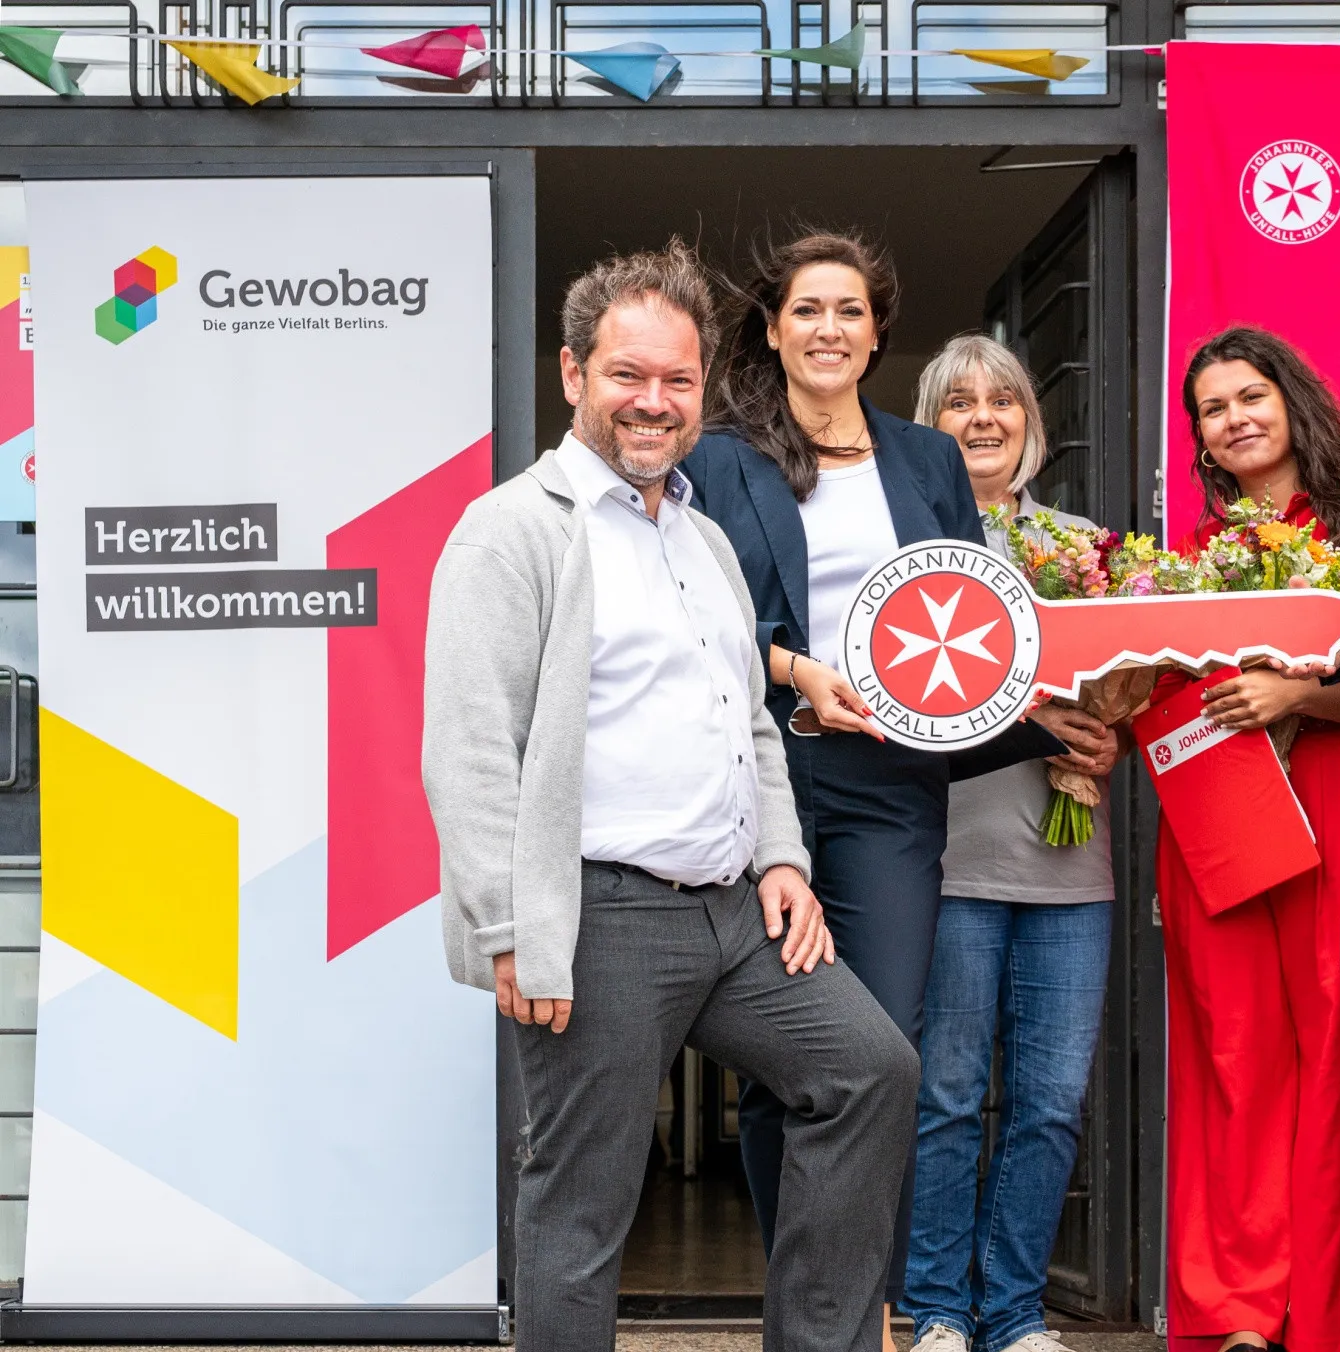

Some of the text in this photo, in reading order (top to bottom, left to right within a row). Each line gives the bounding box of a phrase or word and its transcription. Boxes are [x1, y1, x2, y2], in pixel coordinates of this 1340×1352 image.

[1250, 211, 1335, 241] UNFALL-HILFE
[199, 268, 429, 316] Gewobag
[202, 316, 388, 334] Die ganze Vielfalt Berlins.
[95, 517, 267, 553] Herzlich
[95, 582, 365, 620] willkommen!
[861, 550, 1024, 616] JOHANNITER-
